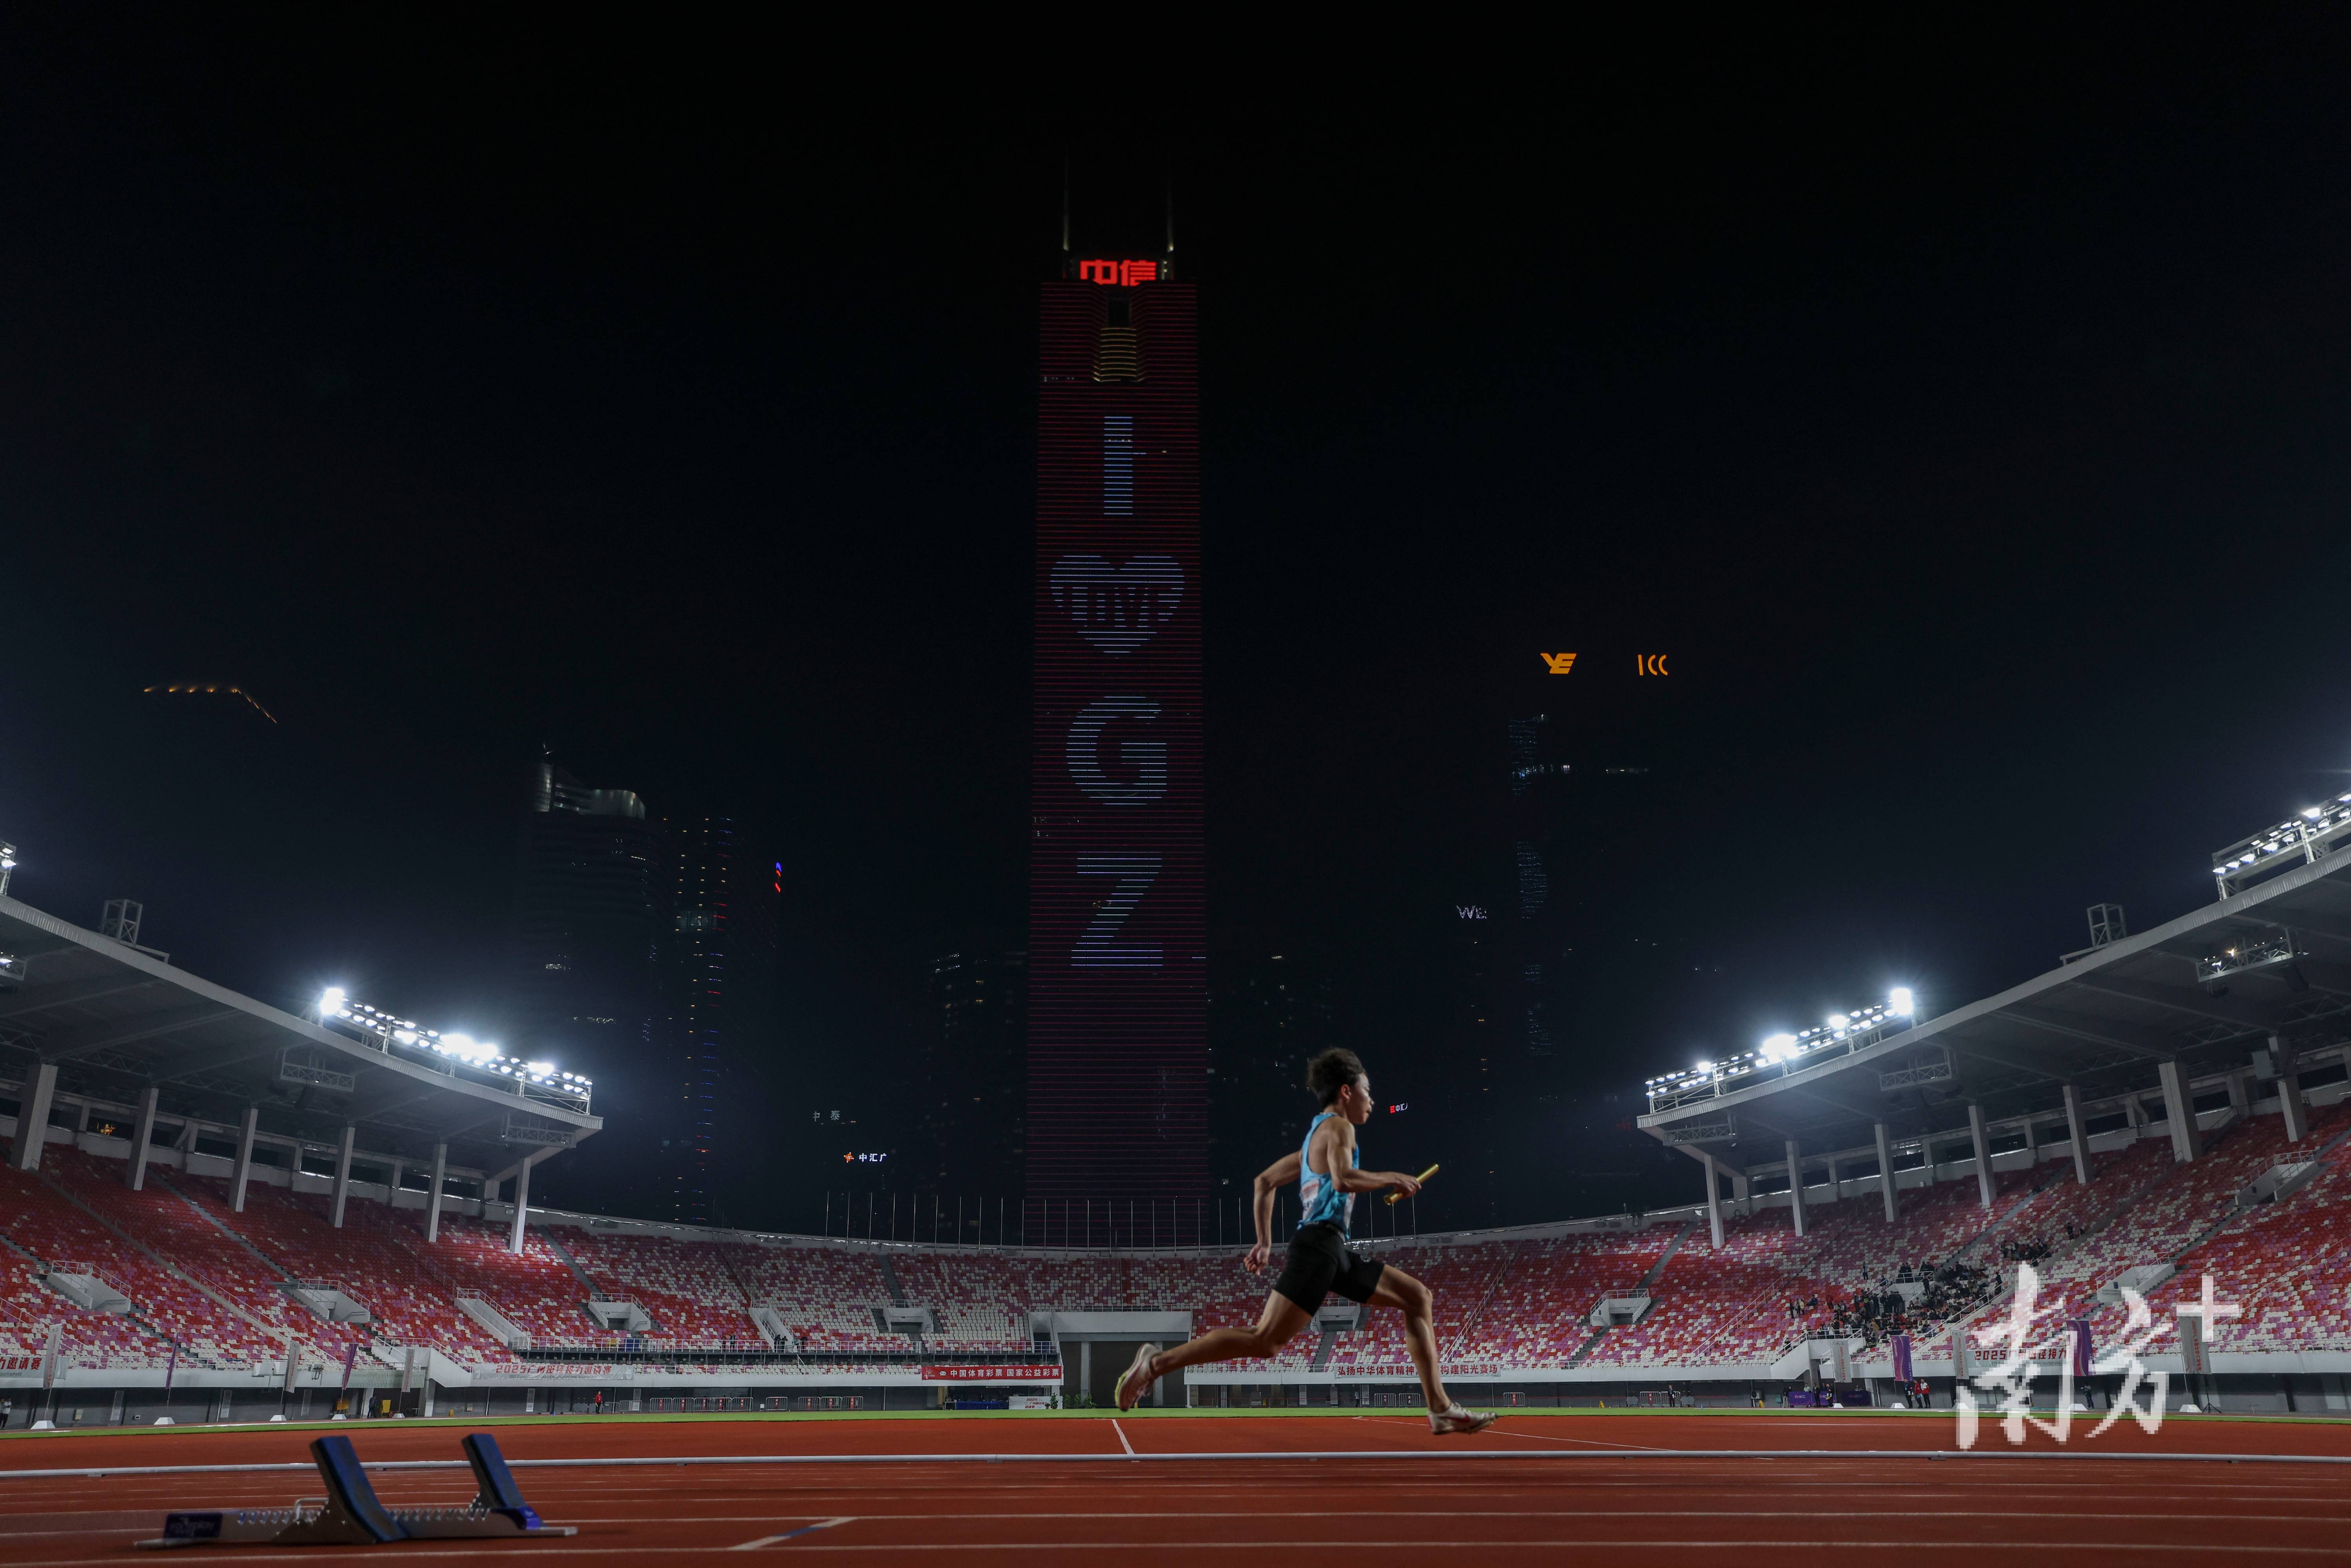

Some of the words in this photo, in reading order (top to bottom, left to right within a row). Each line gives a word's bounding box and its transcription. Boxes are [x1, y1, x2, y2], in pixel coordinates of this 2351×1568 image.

[1080, 260, 1156, 286] 中信
[1638, 654, 1668, 676] ICC
[950, 1368, 1003, 1377] 中国体育彩票
[1006, 1368, 1060, 1377] 国家公益彩票
